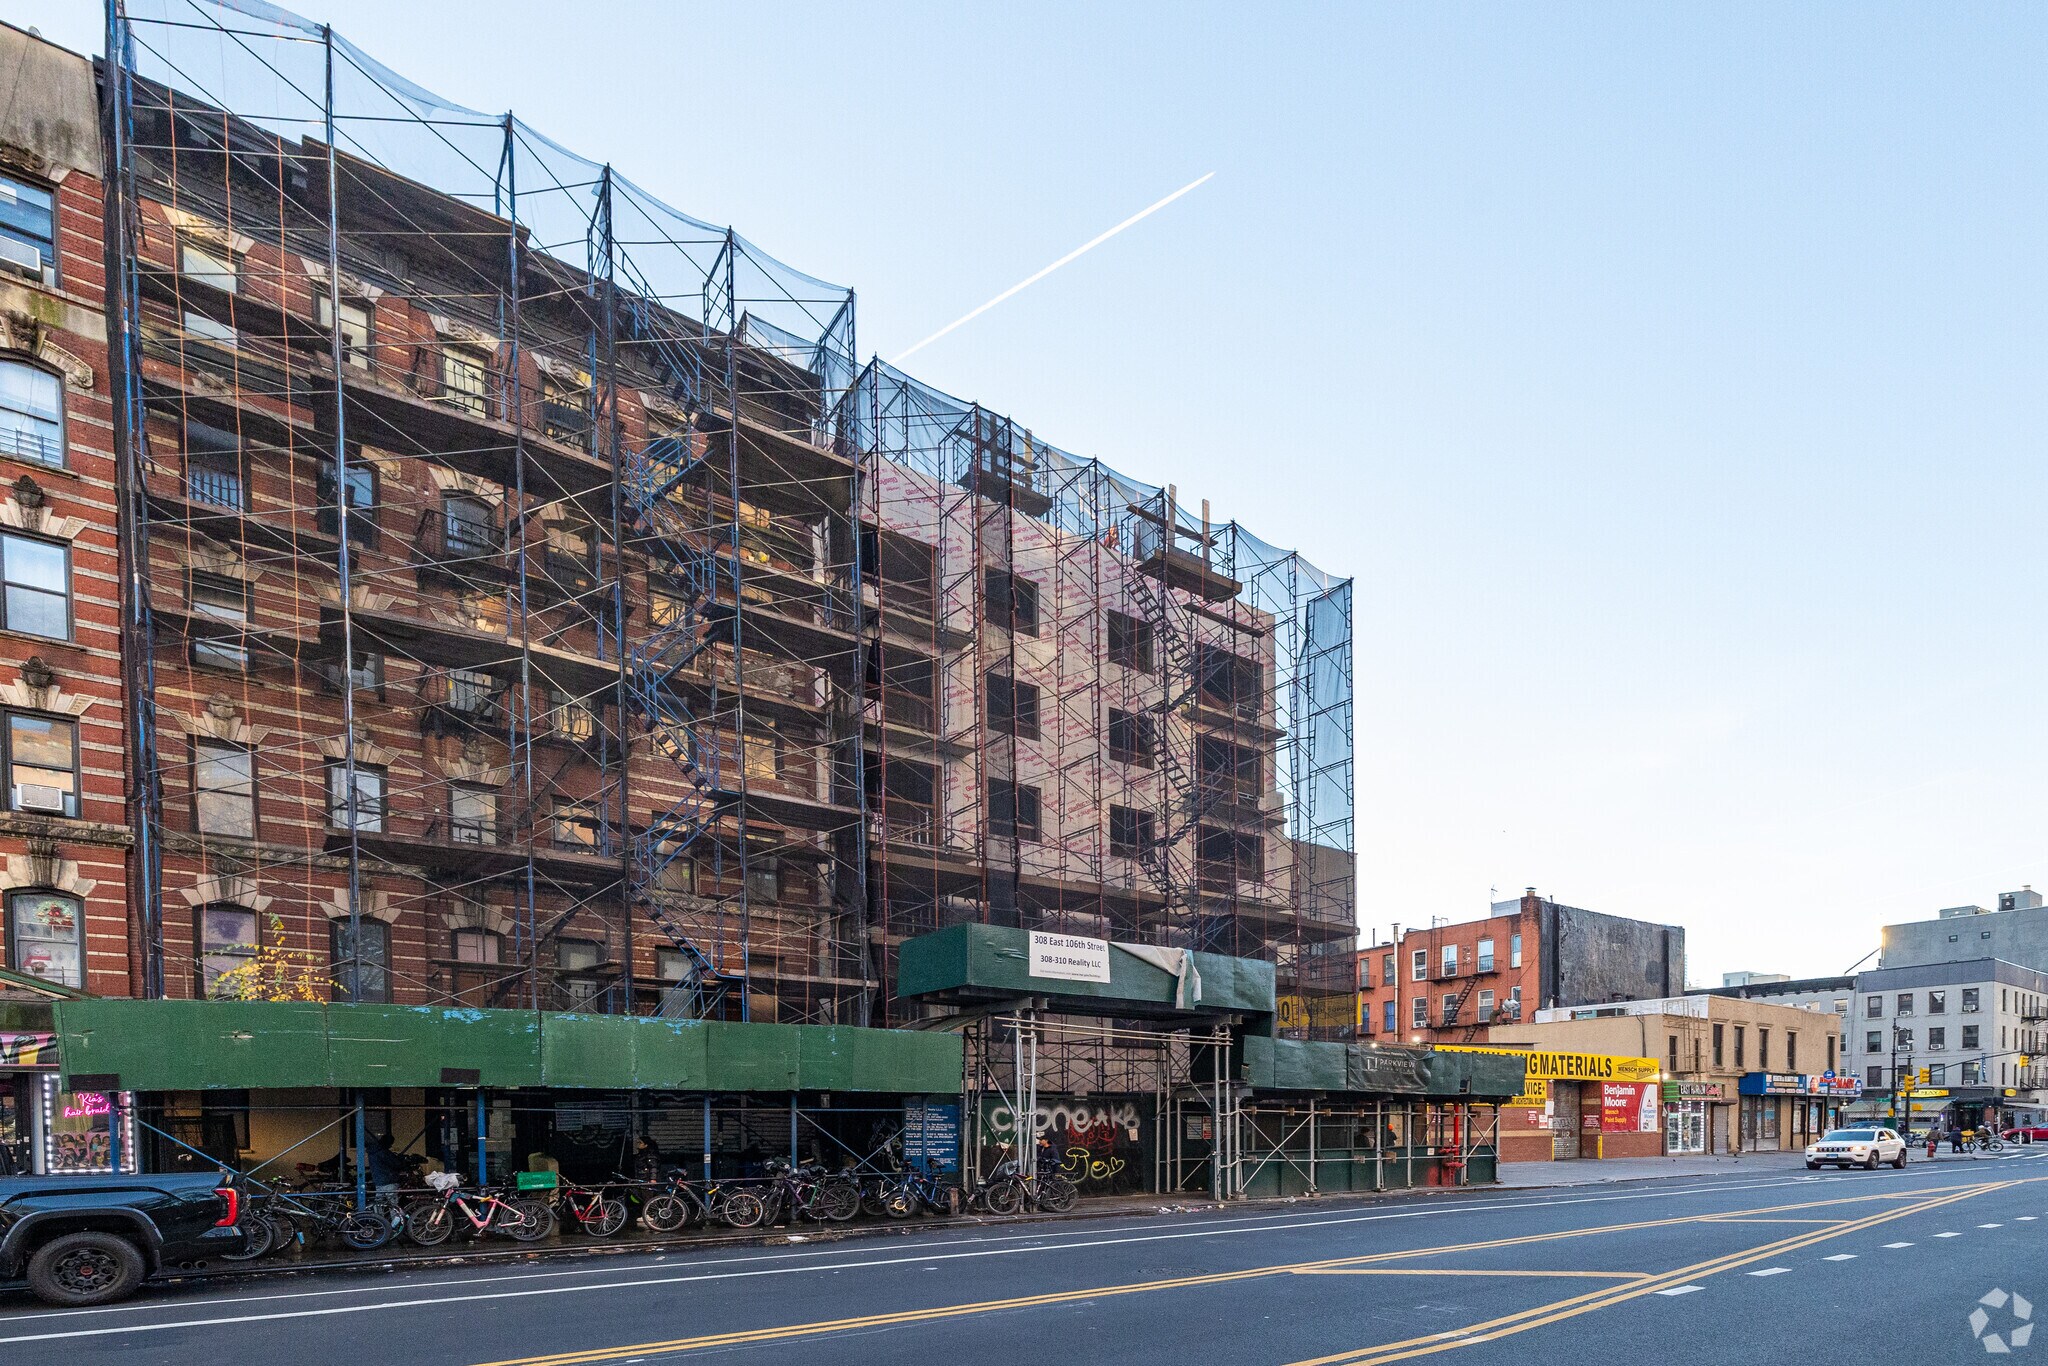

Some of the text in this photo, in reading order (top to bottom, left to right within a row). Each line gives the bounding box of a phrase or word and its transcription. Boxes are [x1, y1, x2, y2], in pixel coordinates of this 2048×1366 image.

[1034, 935, 1106, 952] 308 East 106th Street
[1040, 955, 1101, 968] 308-310 Reality LLC
[1379, 1058, 1415, 1068] PARKVIEW
[1540, 1053, 1612, 1078] MATERIALS
[1604, 1084, 1636, 1097] Benjamin
[77, 1092, 105, 1107] Kia's
[1604, 1097, 1627, 1107] Moore
[64, 1102, 110, 1118] hair braid
